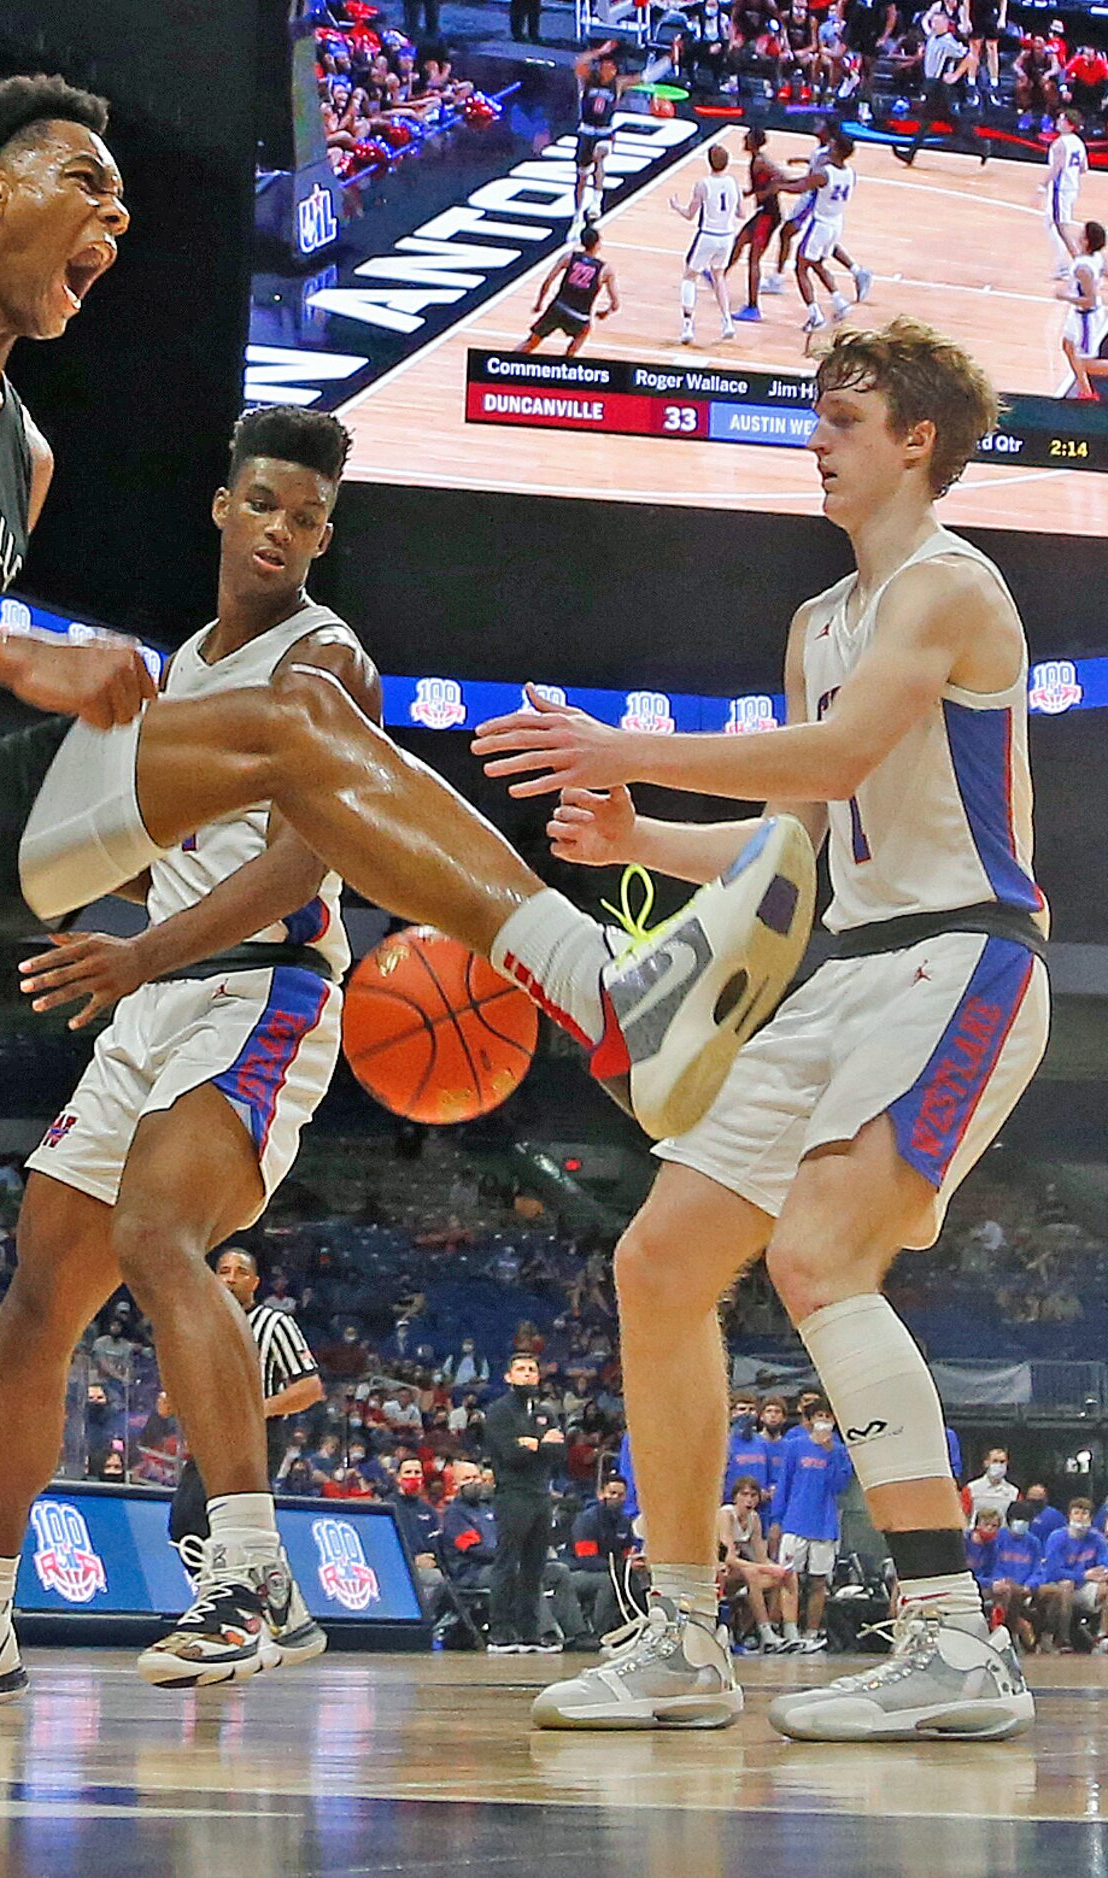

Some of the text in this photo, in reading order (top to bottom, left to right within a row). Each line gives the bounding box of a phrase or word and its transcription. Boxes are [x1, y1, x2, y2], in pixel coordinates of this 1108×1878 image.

[487, 357, 610, 383] Commentators
[635, 369, 684, 390] Roger
[686, 373, 748, 394] Wallace
[768, 381, 798, 399] Jim
[484, 394, 604, 420] DUNCANVILLE
[664, 406, 698, 432] 33
[729, 414, 786, 434] AUSTIN
[995, 434, 1023, 452] Qtr
[1050, 439, 1089, 458] 2:14
[417, 678, 460, 704] 100
[1034, 662, 1075, 688] 100
[627, 692, 670, 718] 100
[730, 697, 772, 722] 100
[911, 997, 1001, 1157] WESTLAKE
[30, 1501, 92, 1555] 100
[312, 1518, 364, 1565] 100
